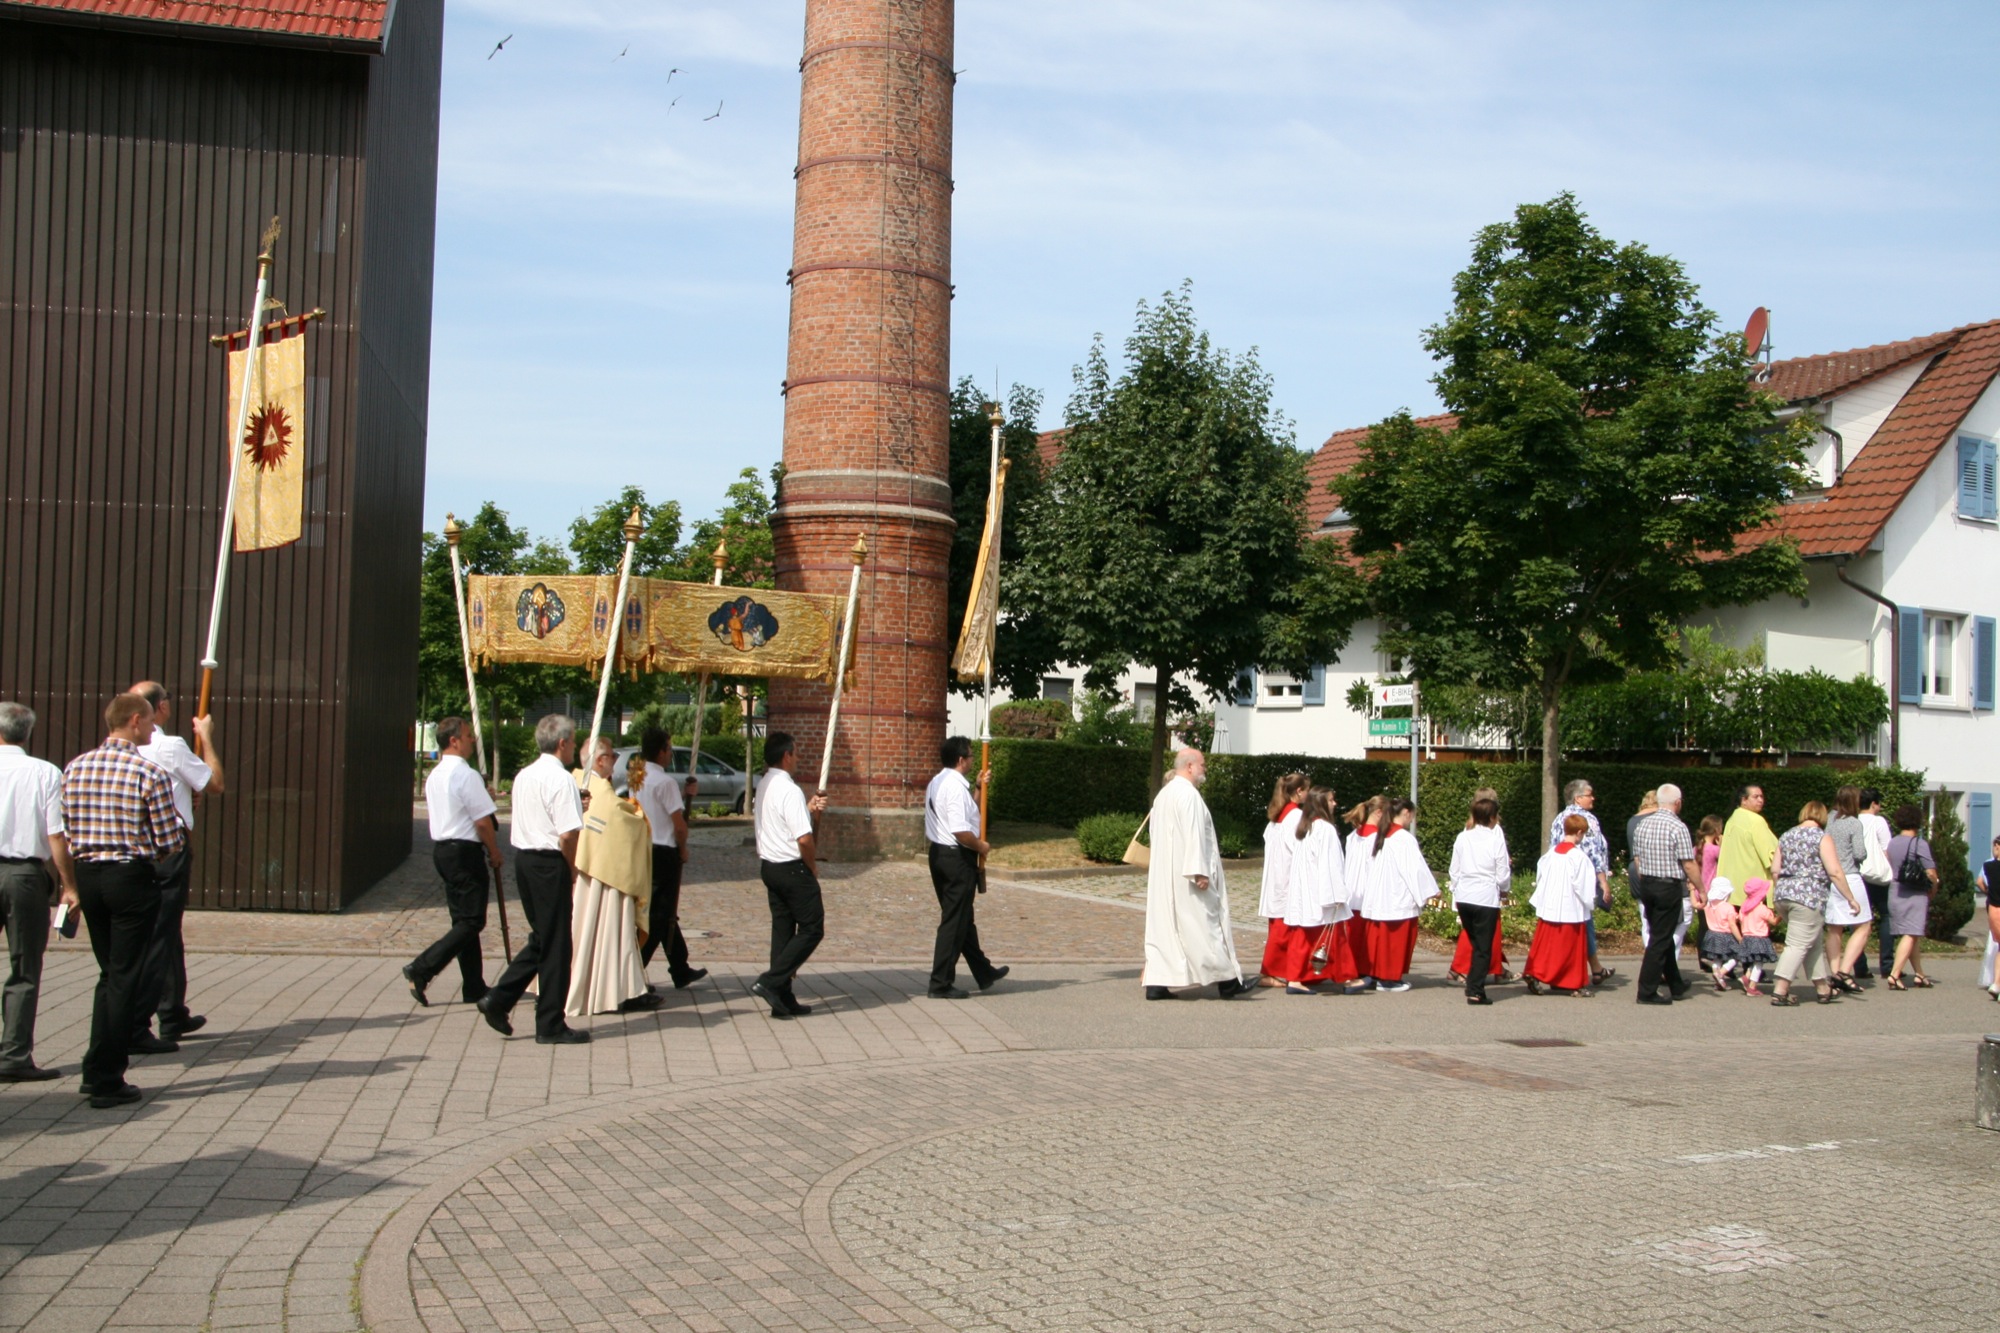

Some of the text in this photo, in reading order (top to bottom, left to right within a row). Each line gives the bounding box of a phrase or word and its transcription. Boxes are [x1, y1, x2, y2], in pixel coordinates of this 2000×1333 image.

[1391, 687, 1412, 696] E-BIKE
[1371, 721, 1380, 731] Am
[1381, 721, 1397, 731] Kamin
